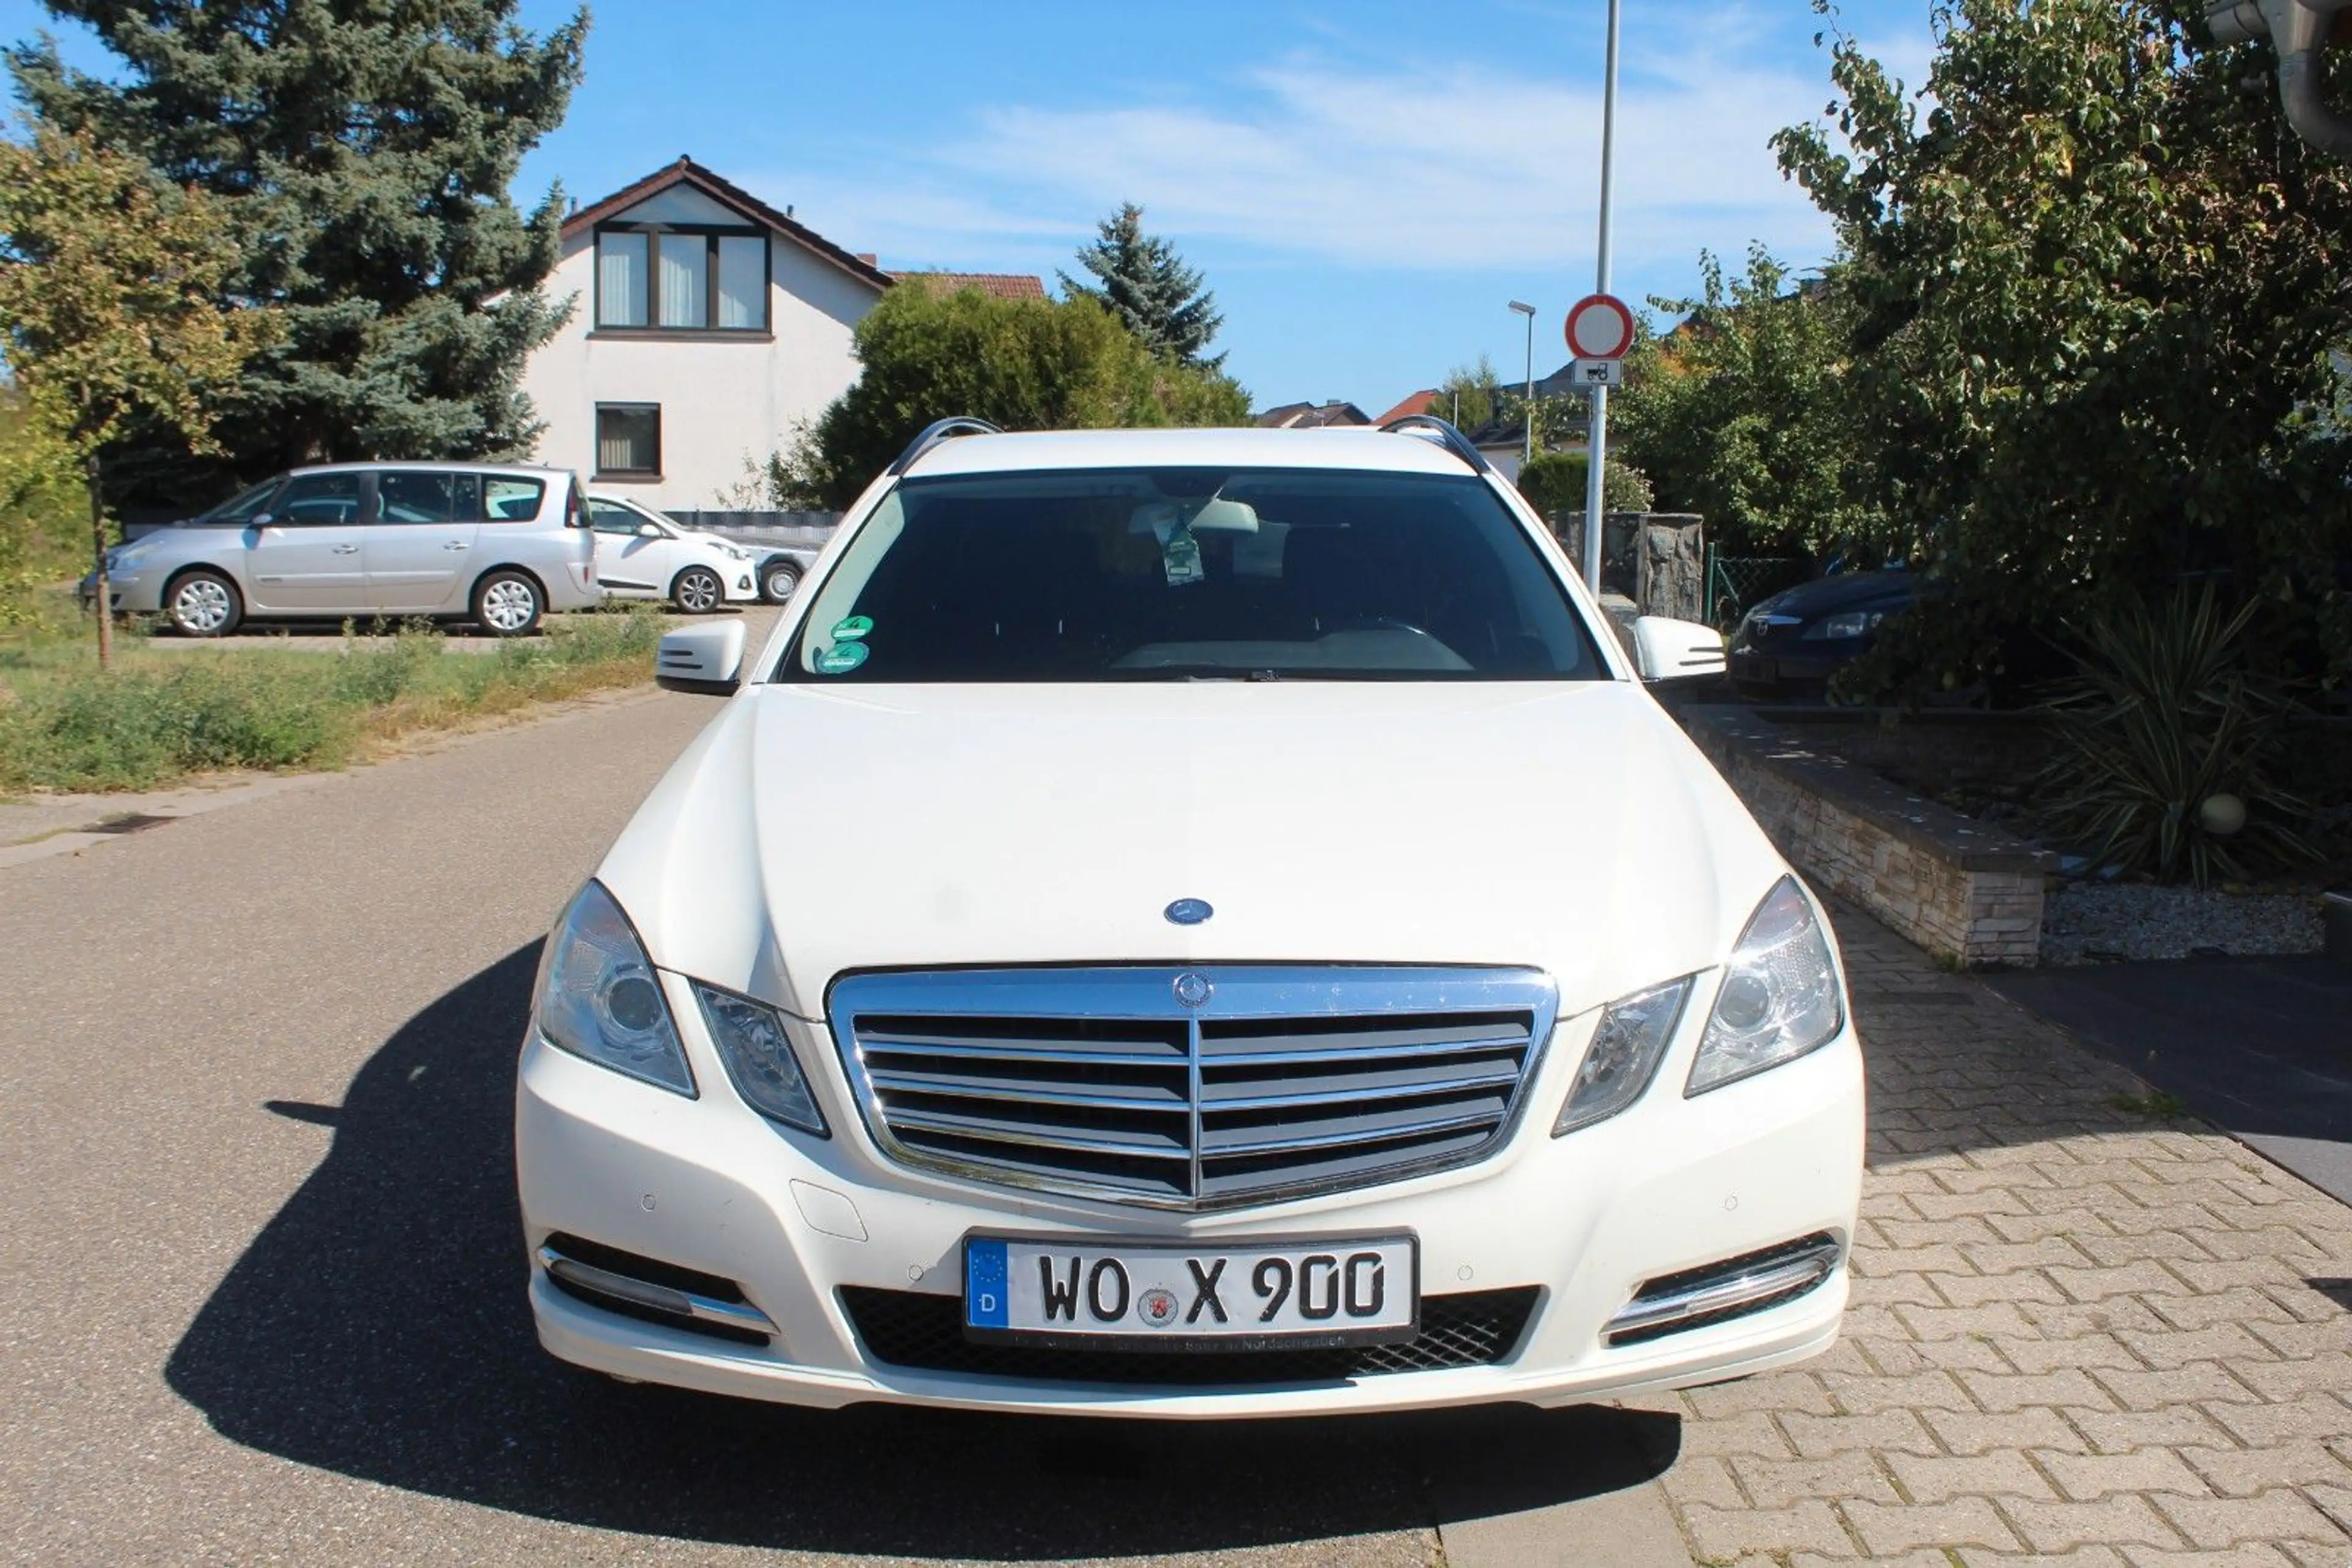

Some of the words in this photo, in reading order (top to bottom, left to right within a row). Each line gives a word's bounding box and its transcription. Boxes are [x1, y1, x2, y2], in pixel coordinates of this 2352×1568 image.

[981, 1294, 995, 1312] D
[1039, 1256, 1130, 1321] WO
[1186, 1259, 1227, 1323] X
[1252, 1252, 1384, 1322] 900
